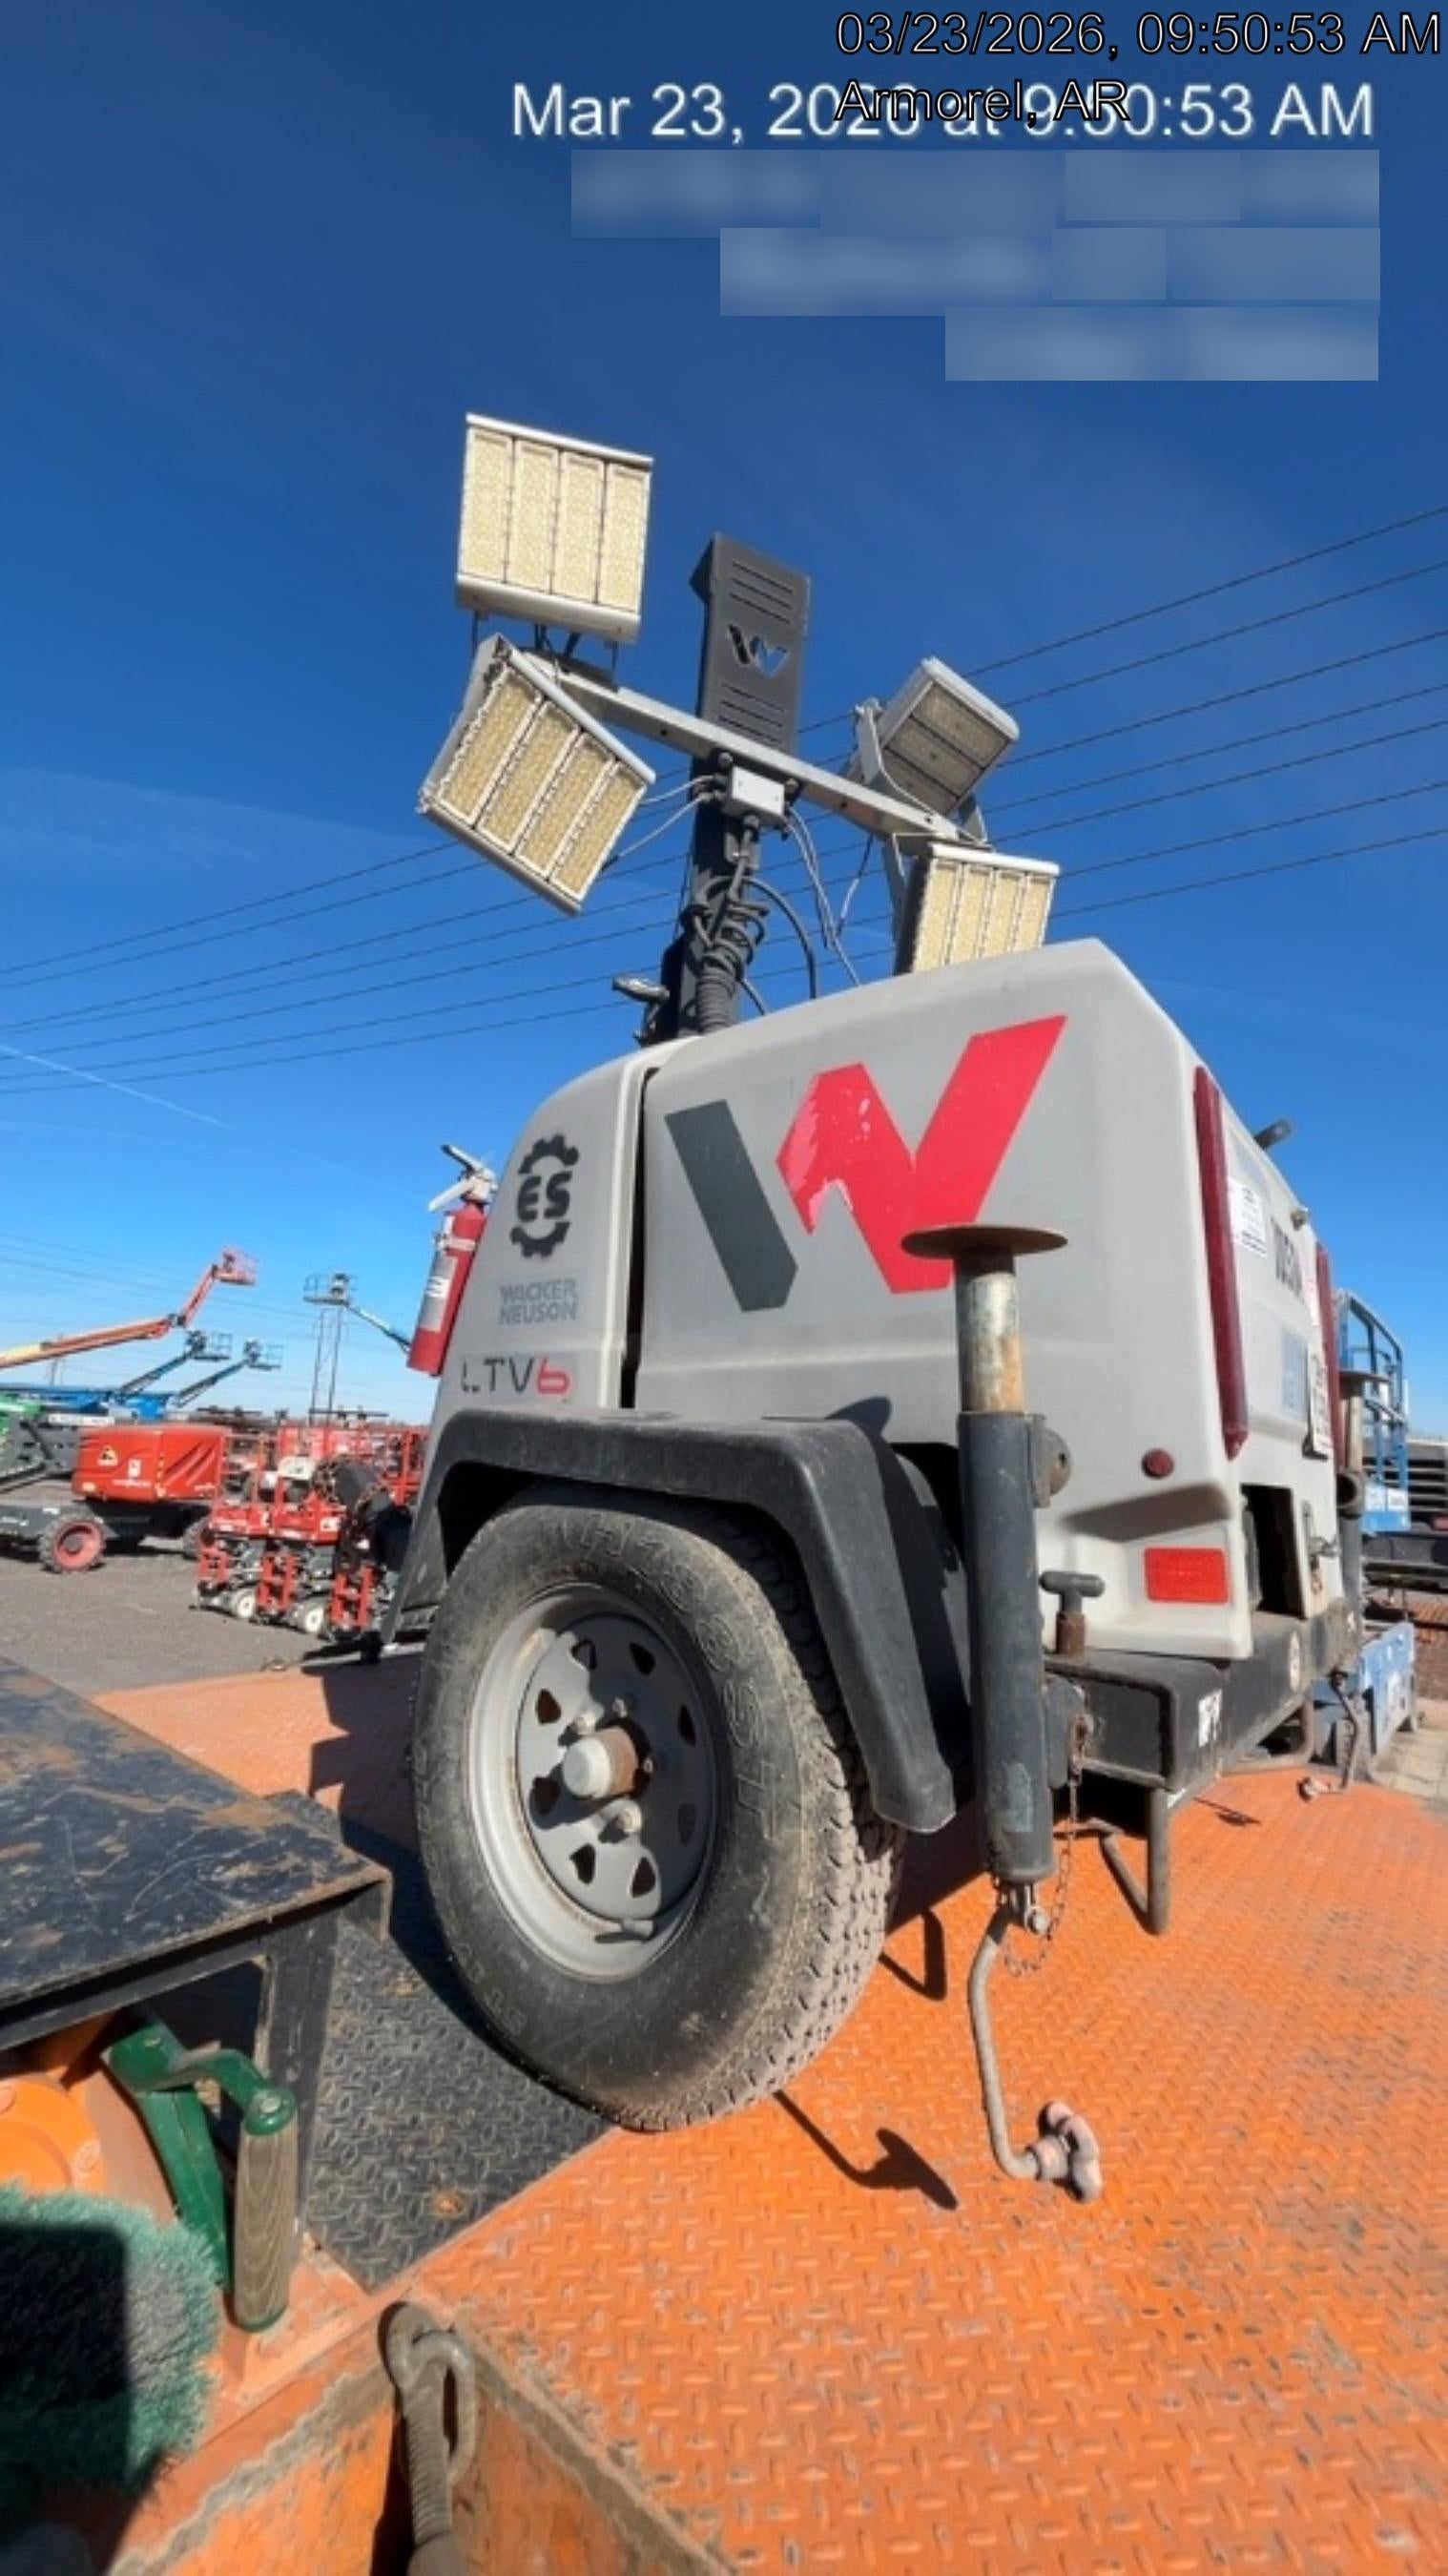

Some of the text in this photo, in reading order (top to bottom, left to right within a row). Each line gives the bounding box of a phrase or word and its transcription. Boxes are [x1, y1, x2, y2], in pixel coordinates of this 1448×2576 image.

[516, 1170, 574, 1223] ES
[500, 1279, 576, 1304] WACKER
[499, 1301, 576, 1325] NEUSON
[460, 1356, 570, 1395] LTV6
